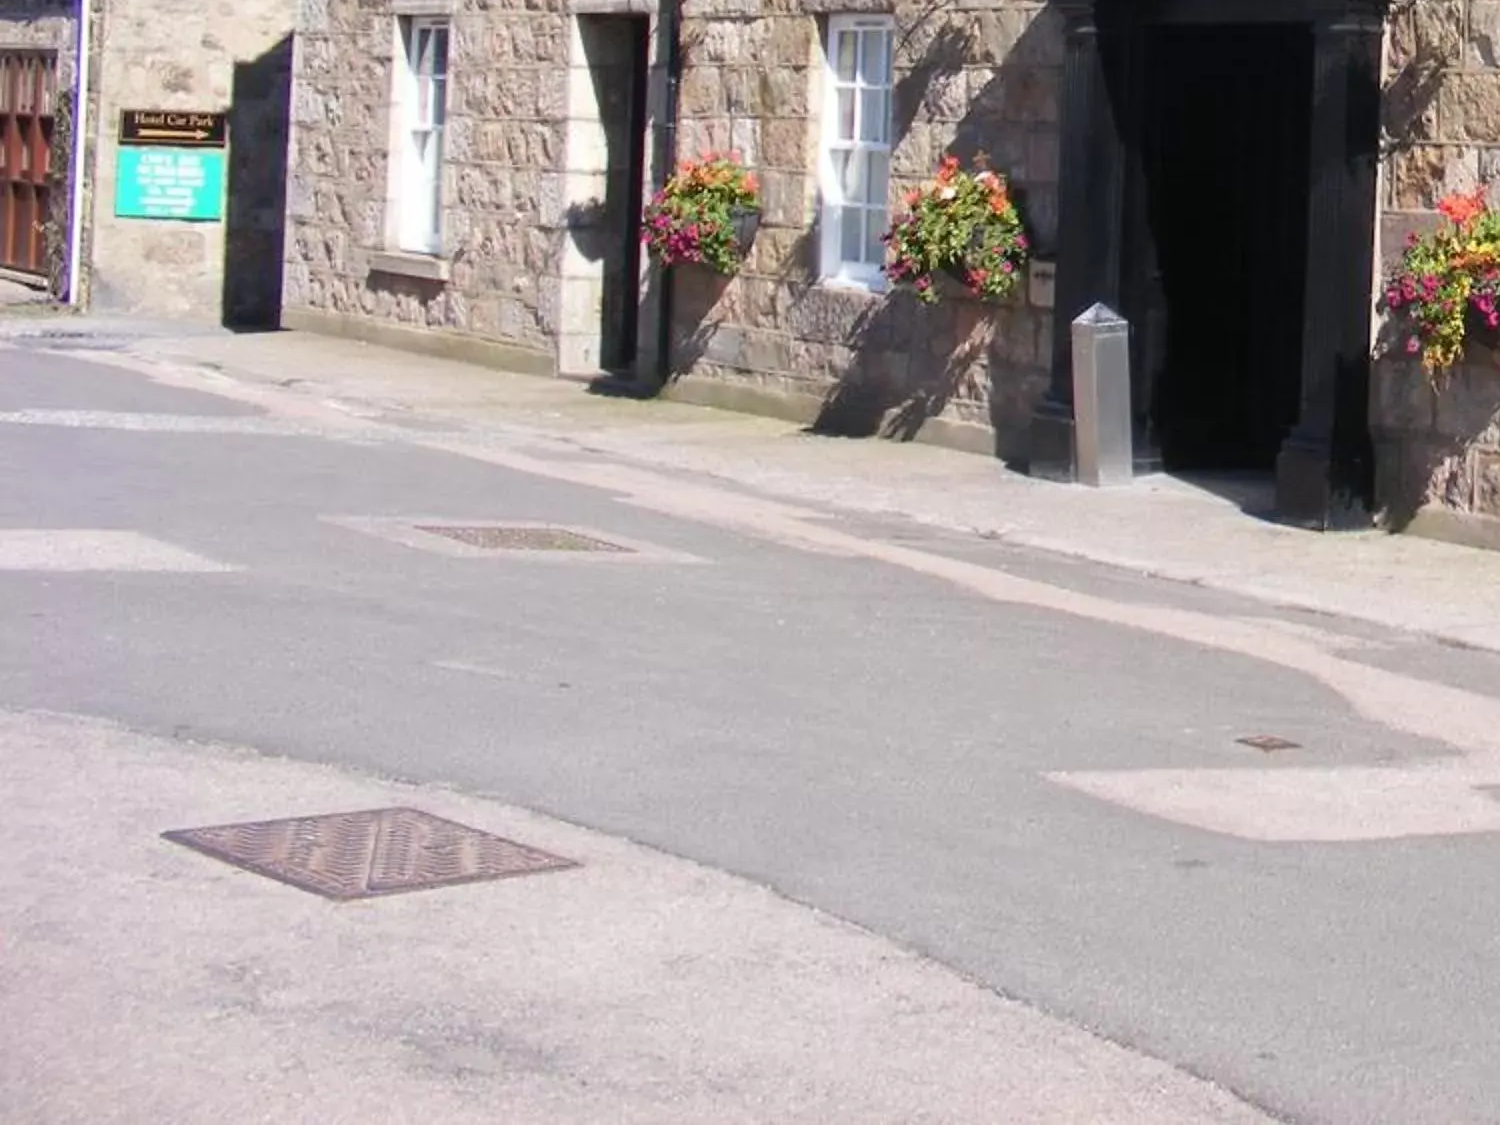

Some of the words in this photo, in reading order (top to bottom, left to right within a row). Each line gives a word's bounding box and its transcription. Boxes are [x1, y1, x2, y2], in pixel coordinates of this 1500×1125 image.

[134, 112, 165, 124] Hotel
[167, 114, 187, 126] Car
[189, 114, 214, 127] Park
